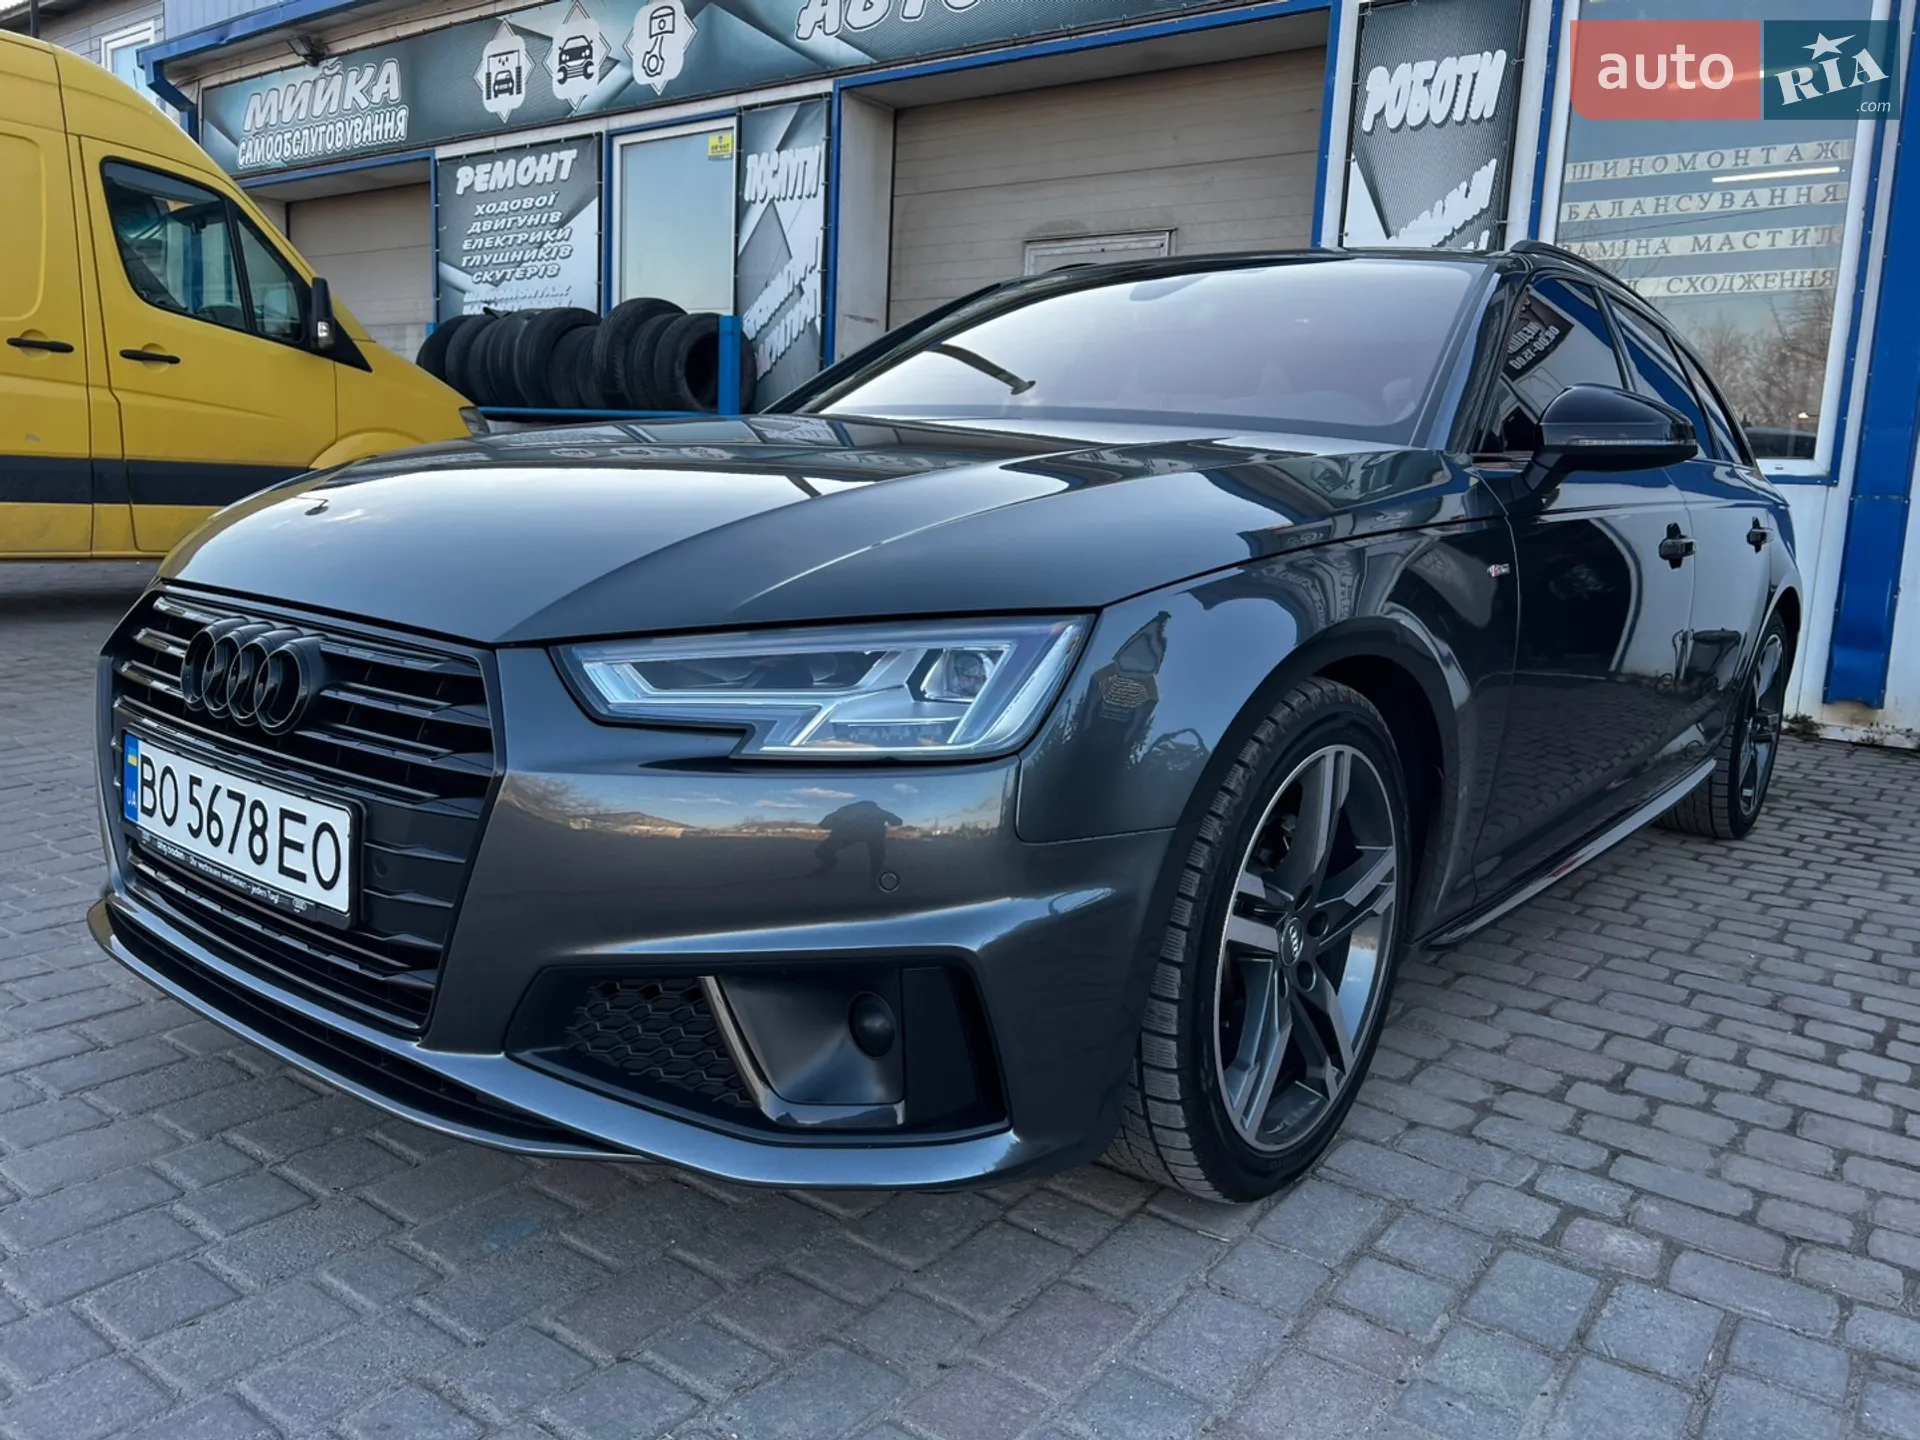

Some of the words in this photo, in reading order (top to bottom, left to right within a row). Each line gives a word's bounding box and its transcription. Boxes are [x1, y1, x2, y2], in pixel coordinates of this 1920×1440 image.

[243, 60, 401, 133] МИЙКА
[1362, 50, 1507, 133] РОБОТИ
[238, 106, 409, 169] САМООБСЛУГОВУВАННЯ
[456, 149, 578, 195] РЕМОНТ
[1571, 141, 1841, 180] ШИНОМОНТАЖ
[474, 191, 559, 217] ХОДОВОЇ
[1567, 183, 1841, 221] БАЛАНСУВАННЯ
[462, 227, 573, 251] ЕЛЕКТРИКИ
[467, 211, 562, 235] ДВИГУНІВ
[461, 244, 573, 268] ГЛУШНИКІВ
[472, 264, 560, 284] СКУТЕРІВ
[1666, 269, 1837, 294] СХОДЖЕННЯ
[187, 774, 269, 866] 5678
